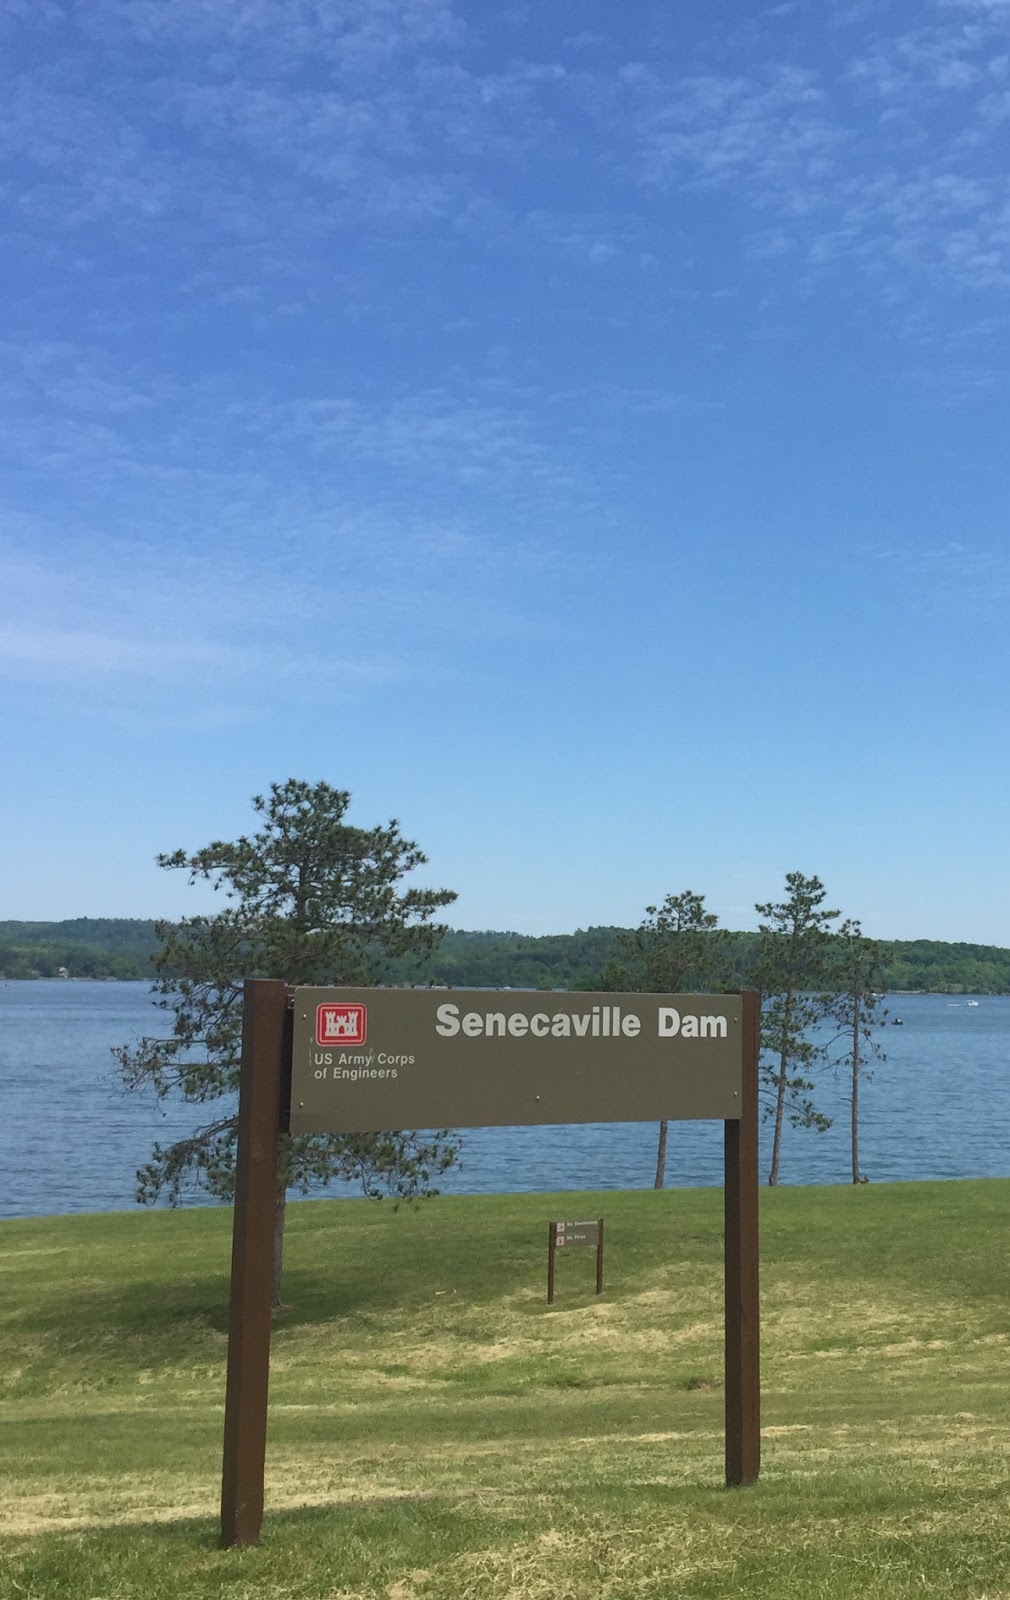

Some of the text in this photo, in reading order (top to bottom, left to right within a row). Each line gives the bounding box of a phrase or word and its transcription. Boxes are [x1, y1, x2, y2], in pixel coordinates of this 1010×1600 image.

[435, 1003, 728, 1038] Senecaville Dam
[314, 1052, 416, 1067] US Army Corps
[314, 1067, 398, 1081] of Engineers
